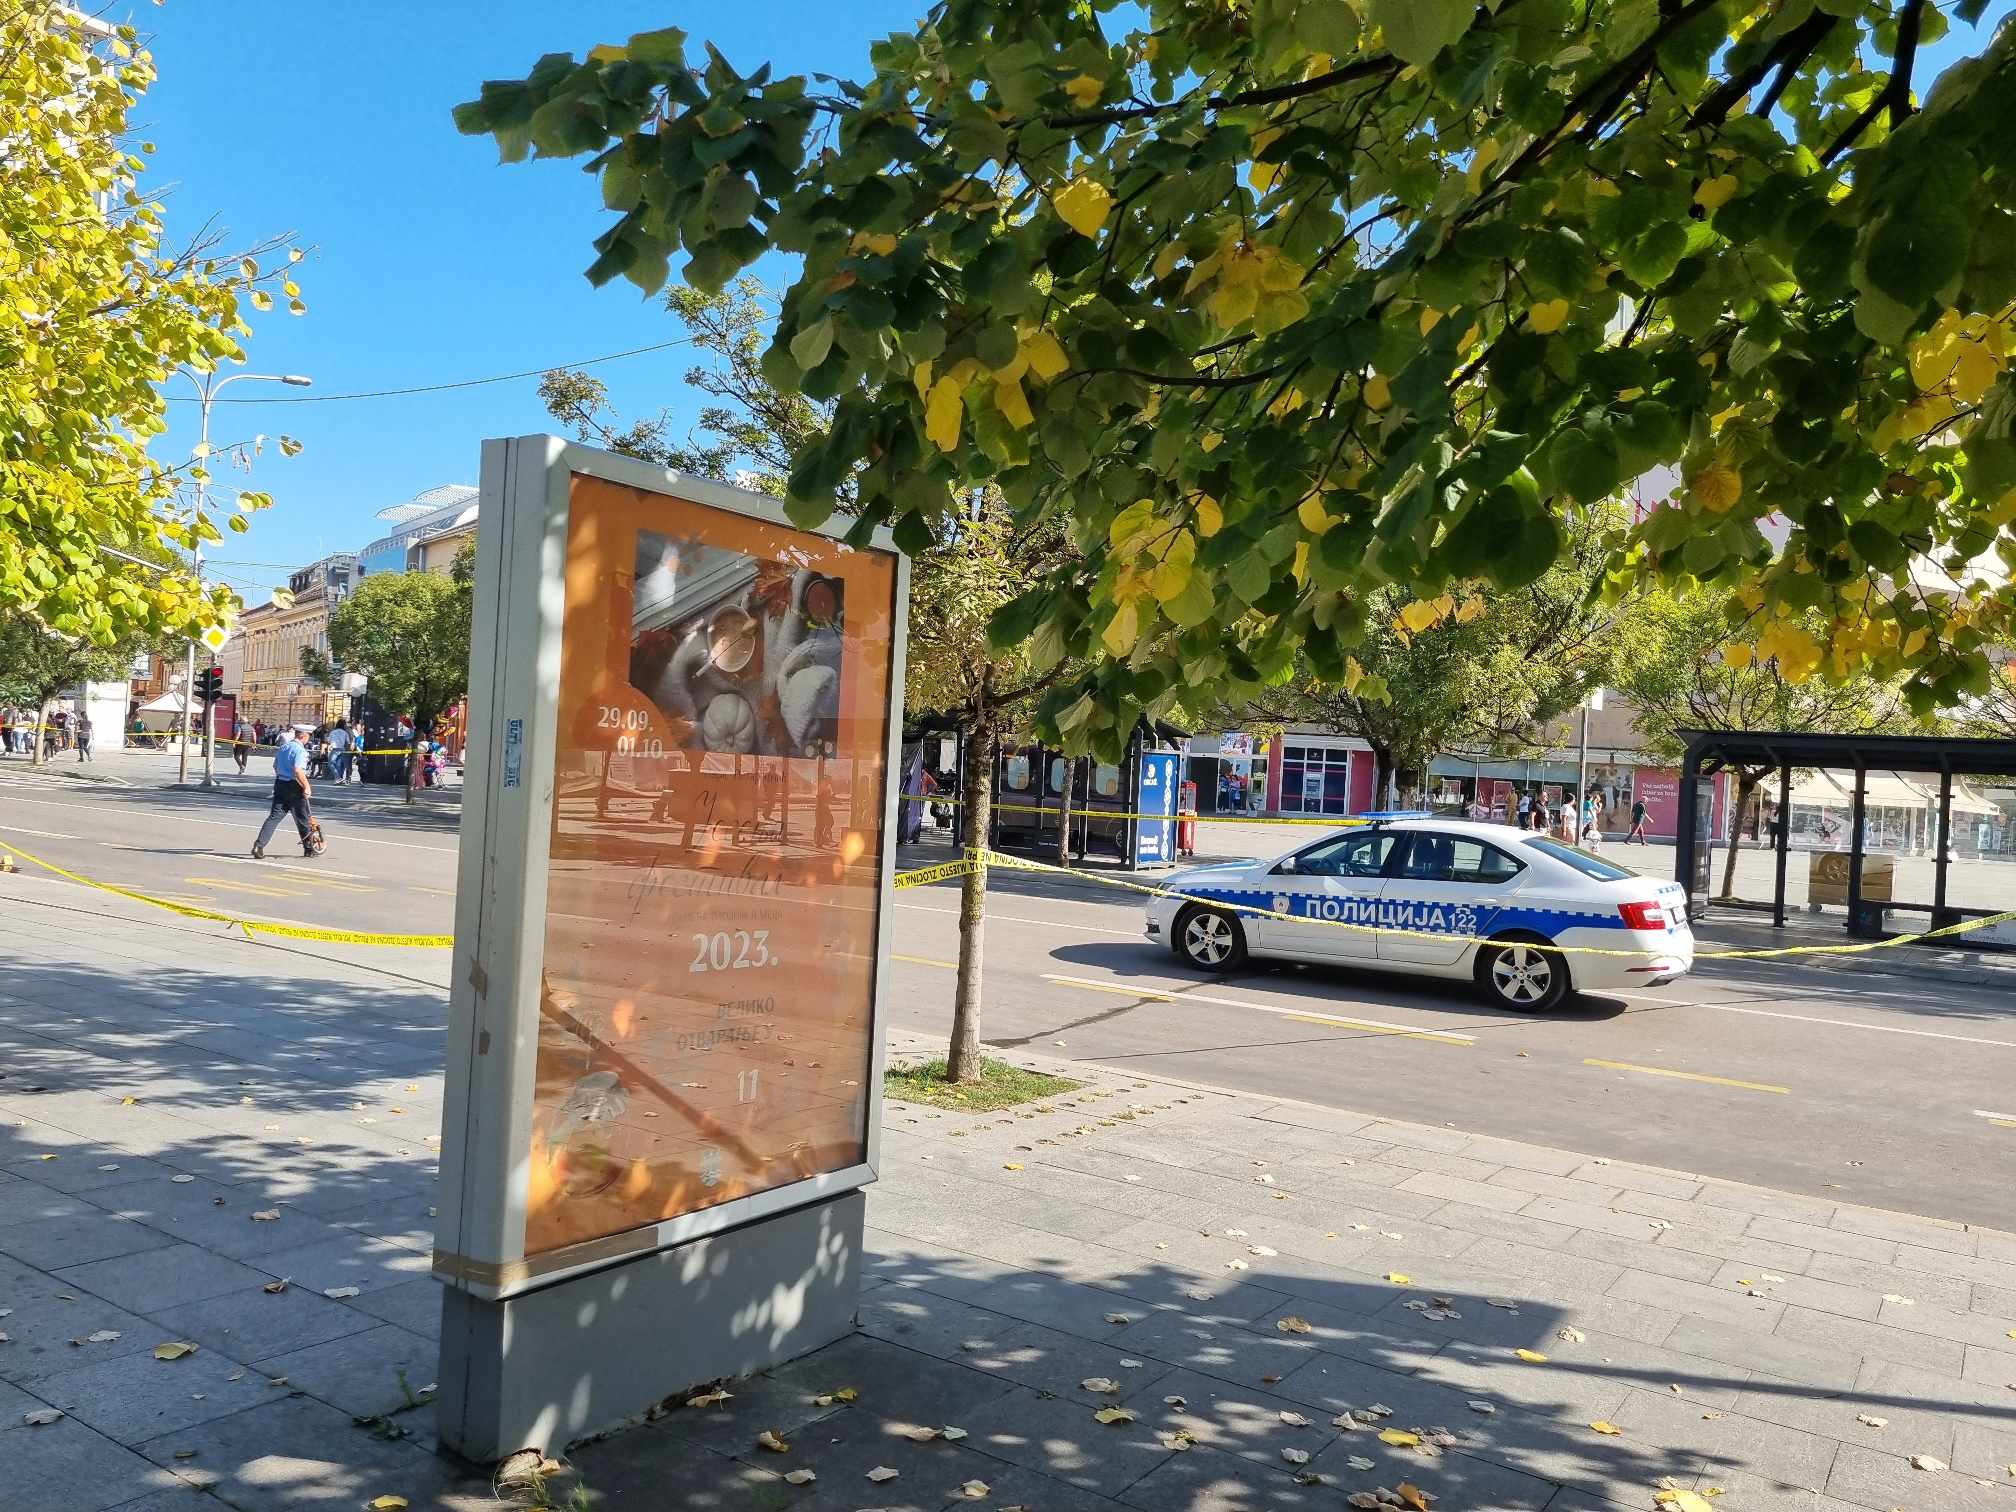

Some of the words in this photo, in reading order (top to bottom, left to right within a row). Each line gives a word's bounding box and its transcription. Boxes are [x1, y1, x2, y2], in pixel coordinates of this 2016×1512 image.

[598, 706, 653, 731] 29.09.
[617, 735, 668, 760] 01.10.
[905, 869, 937, 885] ZLOCINA
[940, 863, 967, 877] MJESTO
[1305, 899, 1446, 928] ПОЛИЦИЈА
[1449, 913, 1477, 929] 122
[689, 929, 779, 973] 2023.
[737, 1069, 760, 1103] 11
